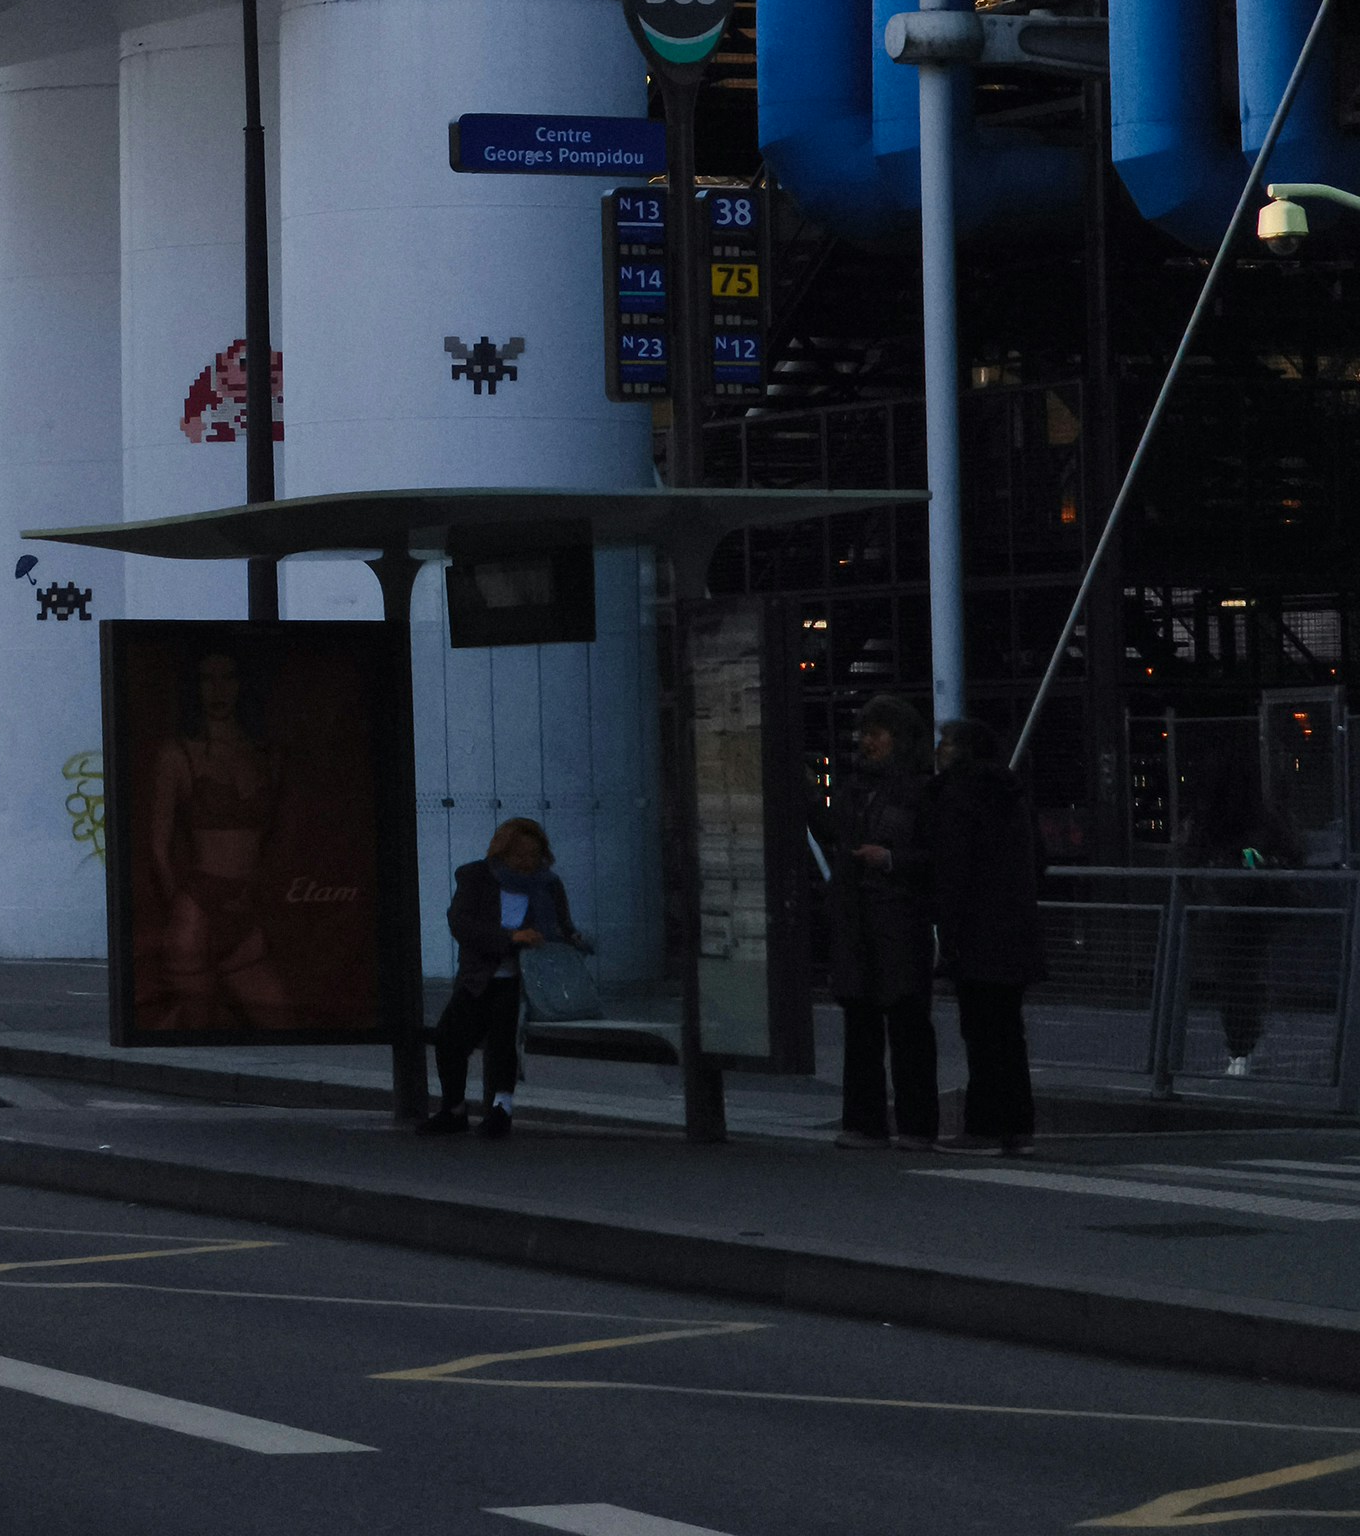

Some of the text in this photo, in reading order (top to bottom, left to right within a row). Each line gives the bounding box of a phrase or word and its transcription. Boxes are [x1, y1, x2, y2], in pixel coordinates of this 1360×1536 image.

[535, 126, 592, 143] Centre
[483, 145, 645, 167] Georges Pompidou
[715, 197, 753, 226] 38
[717, 266, 753, 295] 75
[286, 876, 359, 903] Etam
